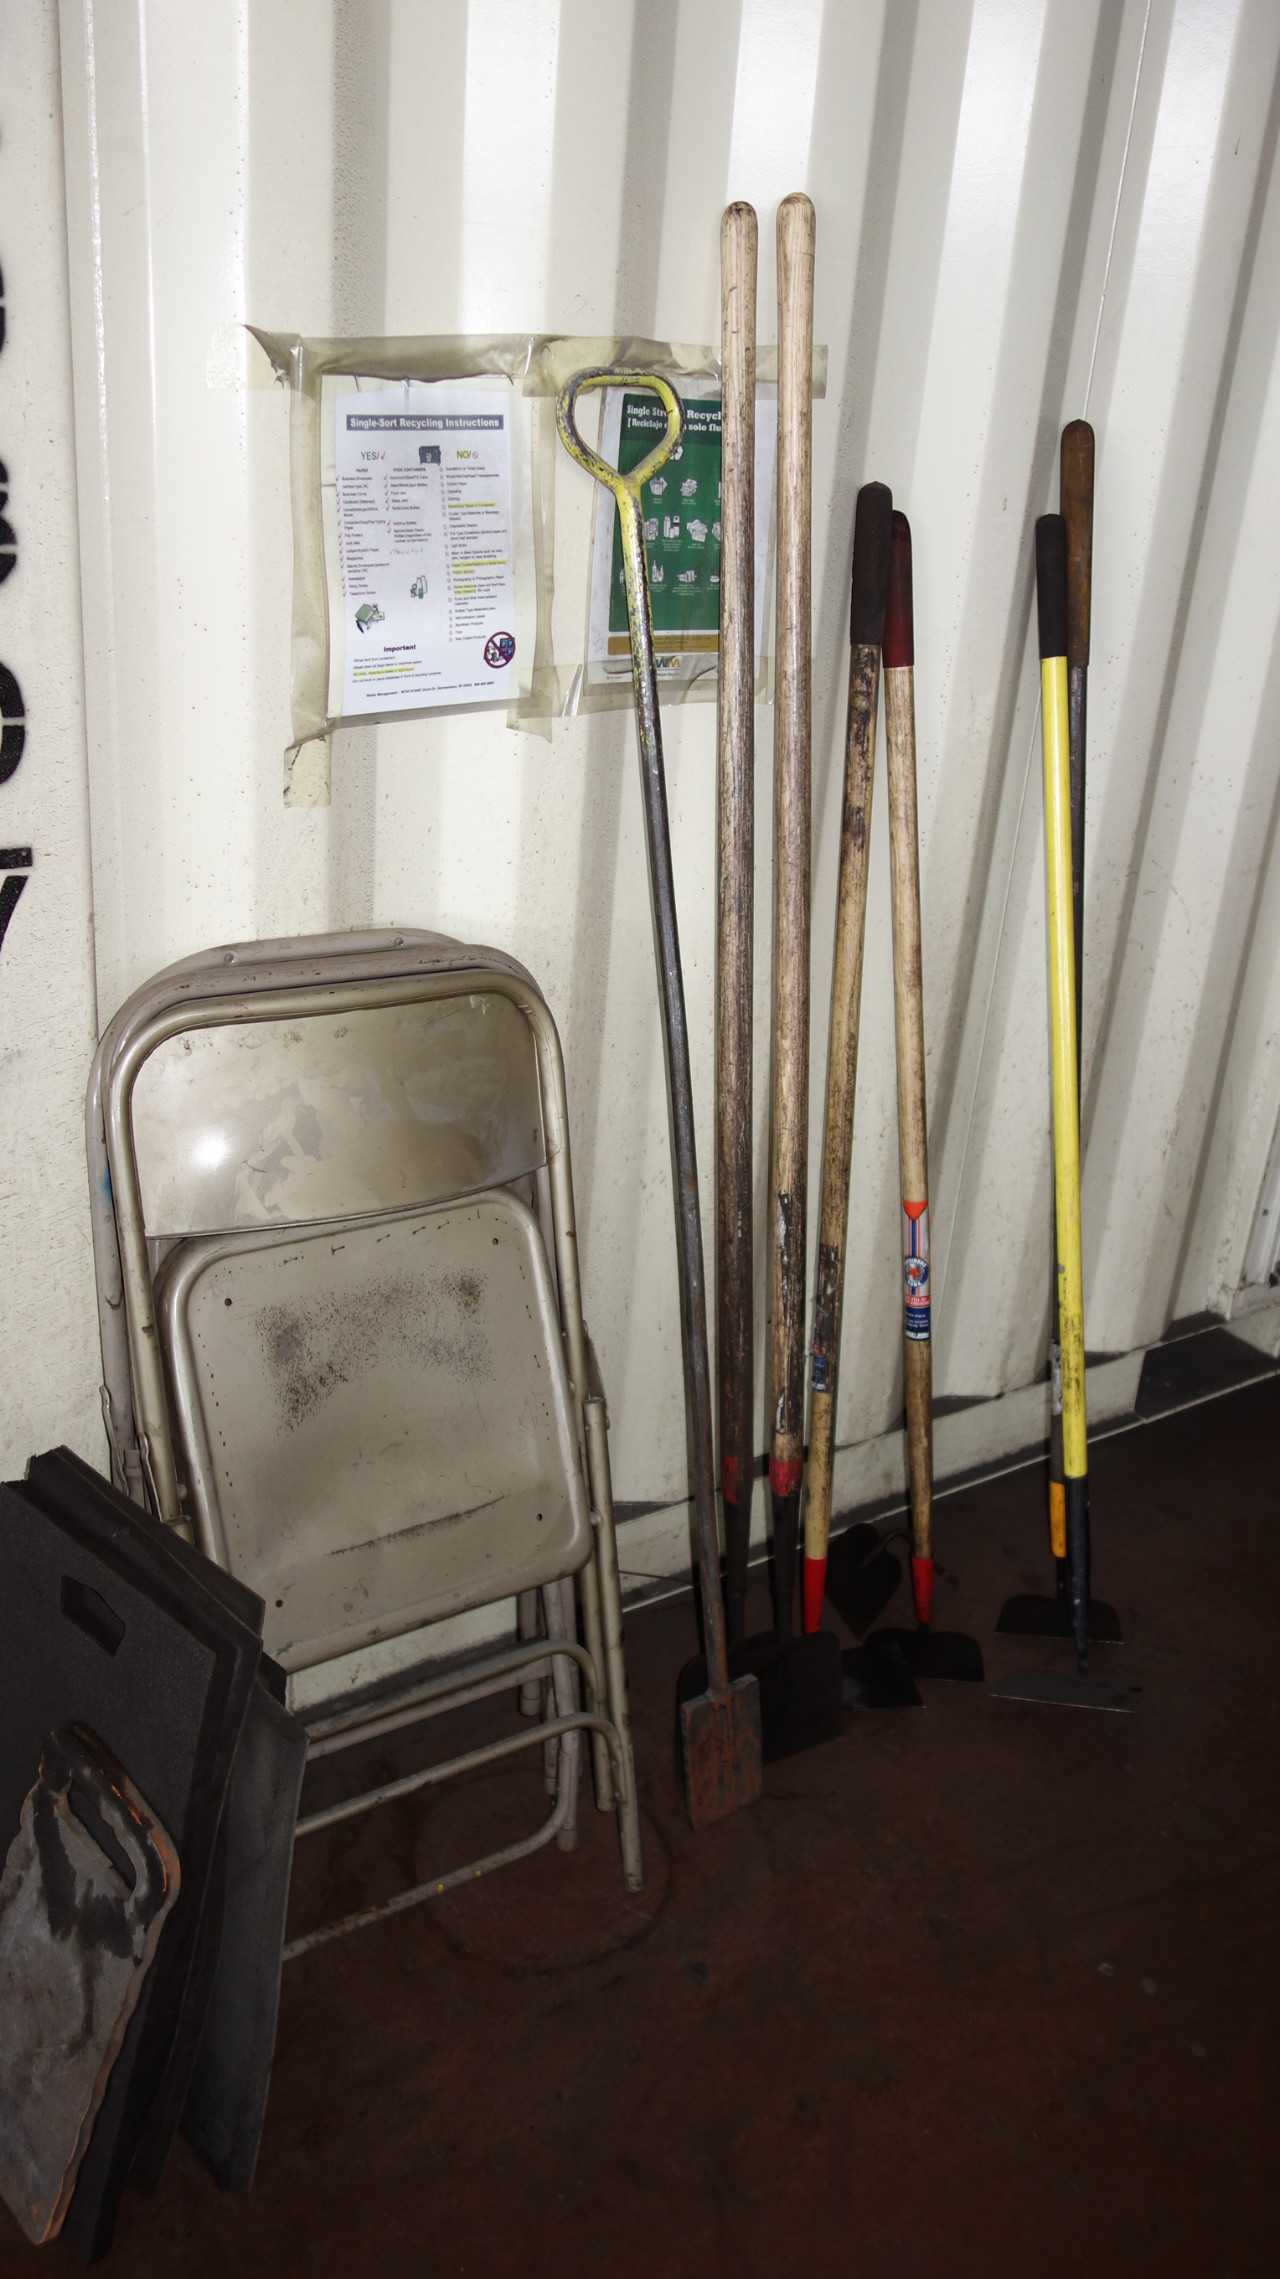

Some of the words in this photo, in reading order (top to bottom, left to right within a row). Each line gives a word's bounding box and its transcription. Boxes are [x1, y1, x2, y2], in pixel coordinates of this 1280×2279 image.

[626, 405, 650, 417] Single
[686, 409, 722, 421] Recycl
[350, 417, 398, 429] Single-Sort
[400, 417, 444, 429] Recycling
[446, 417, 499, 428] Instructions
[688, 423, 709, 432] solo
[383, 644, 417, 653] Important
